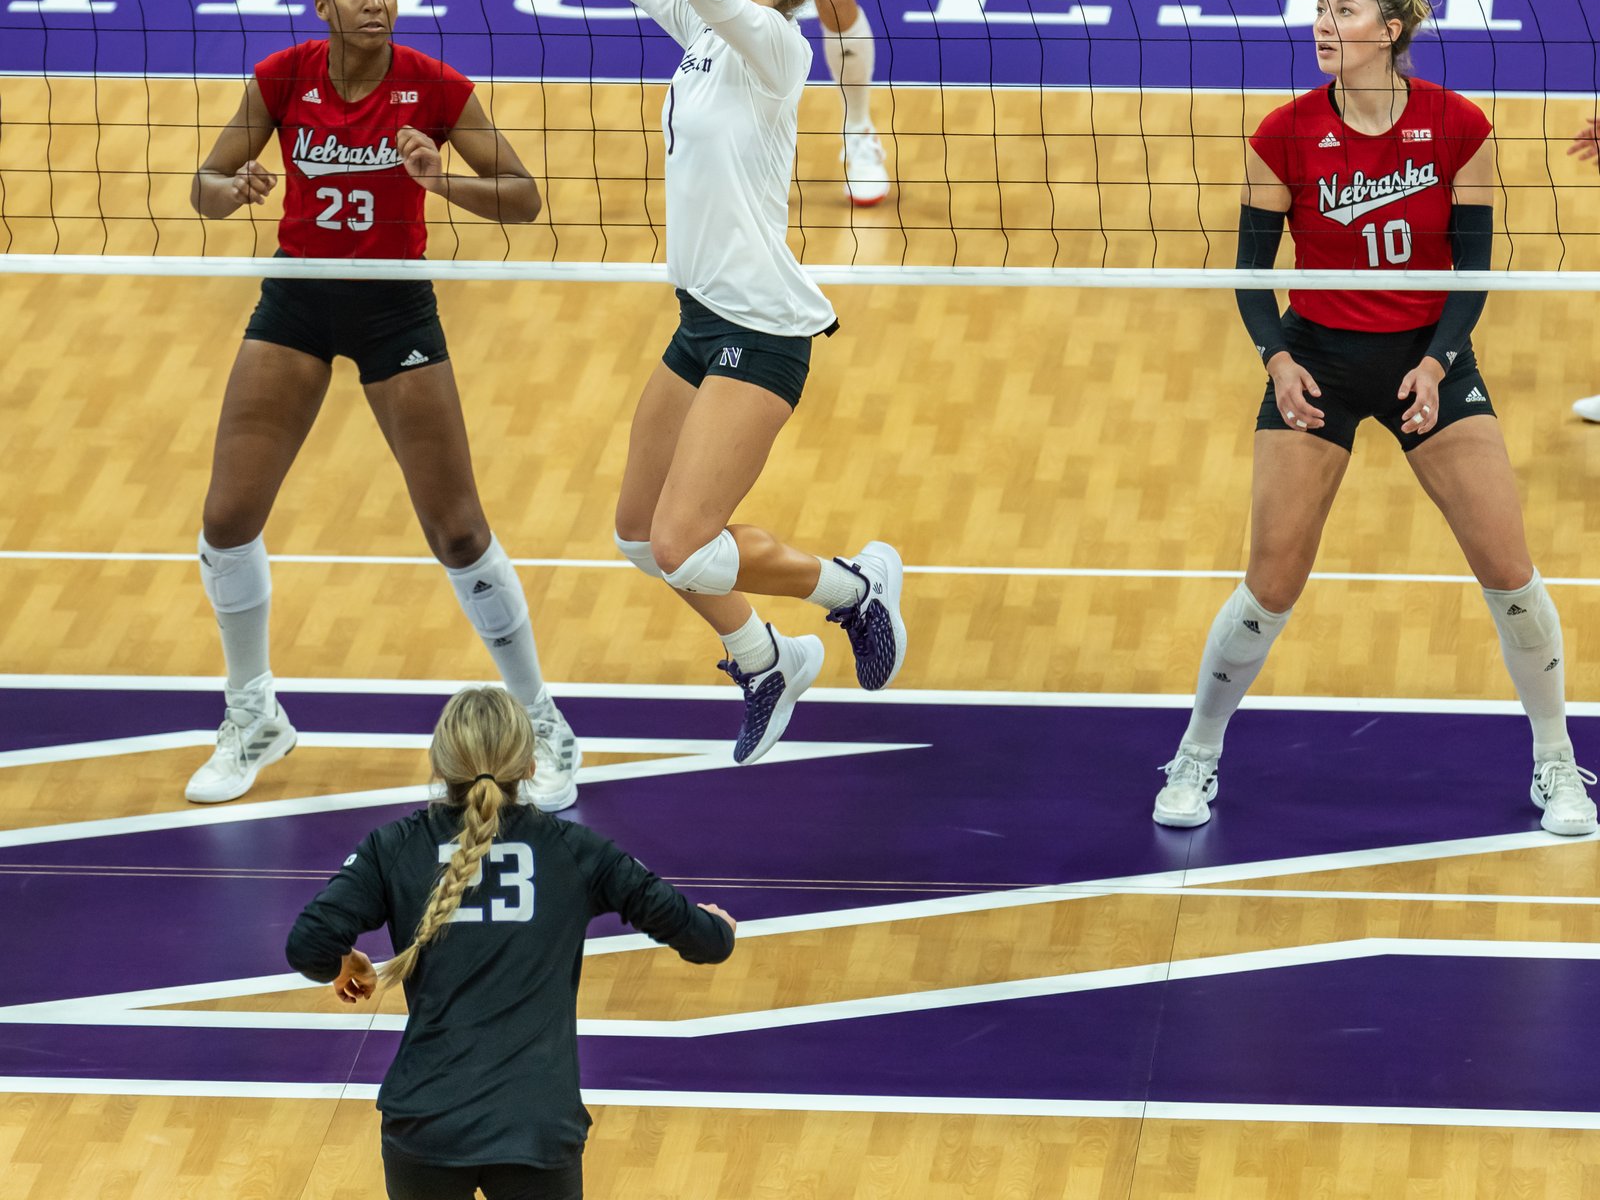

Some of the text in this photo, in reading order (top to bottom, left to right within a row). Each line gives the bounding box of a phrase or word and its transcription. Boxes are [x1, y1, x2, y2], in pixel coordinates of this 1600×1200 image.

[1318, 158, 1439, 213] Nebraska
[315, 187, 375, 232] 23
[1361, 218, 1413, 268] 10
[719, 346, 743, 368] N
